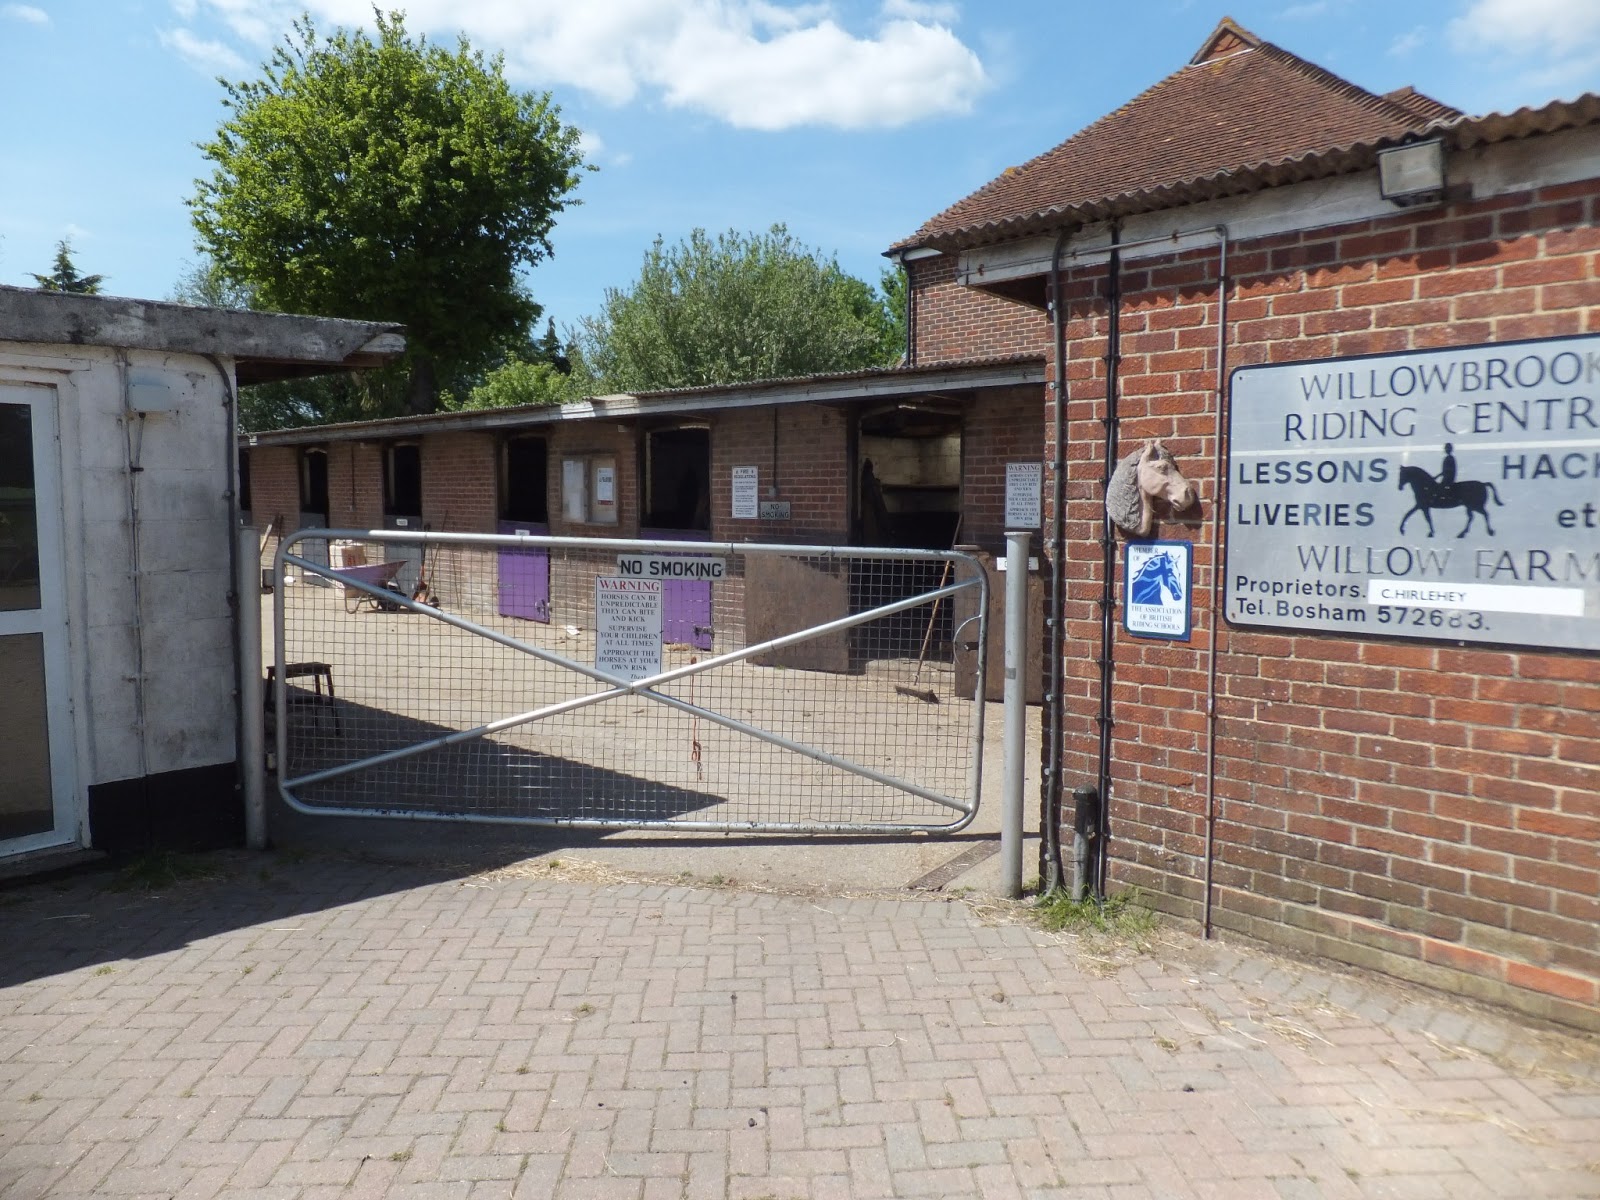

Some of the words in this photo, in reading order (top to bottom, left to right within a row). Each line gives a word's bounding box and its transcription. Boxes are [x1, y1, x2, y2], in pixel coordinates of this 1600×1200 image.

[1300, 352, 1600, 401] WILLOWBROOK
[1284, 408, 1417, 441] RIDING
[1239, 459, 1388, 484] LESSONS
[1237, 503, 1374, 527] LIVERIES
[1557, 502, 1600, 528] et
[620, 560, 642, 574] NO
[650, 561, 722, 577] SMOKING
[1297, 545, 1450, 576] WILLOW
[1474, 549, 1600, 581] FARM
[600, 580, 660, 591] WARNING
[1236, 598, 1271, 616] Tel.
[1276, 600, 1366, 622] Bosham
